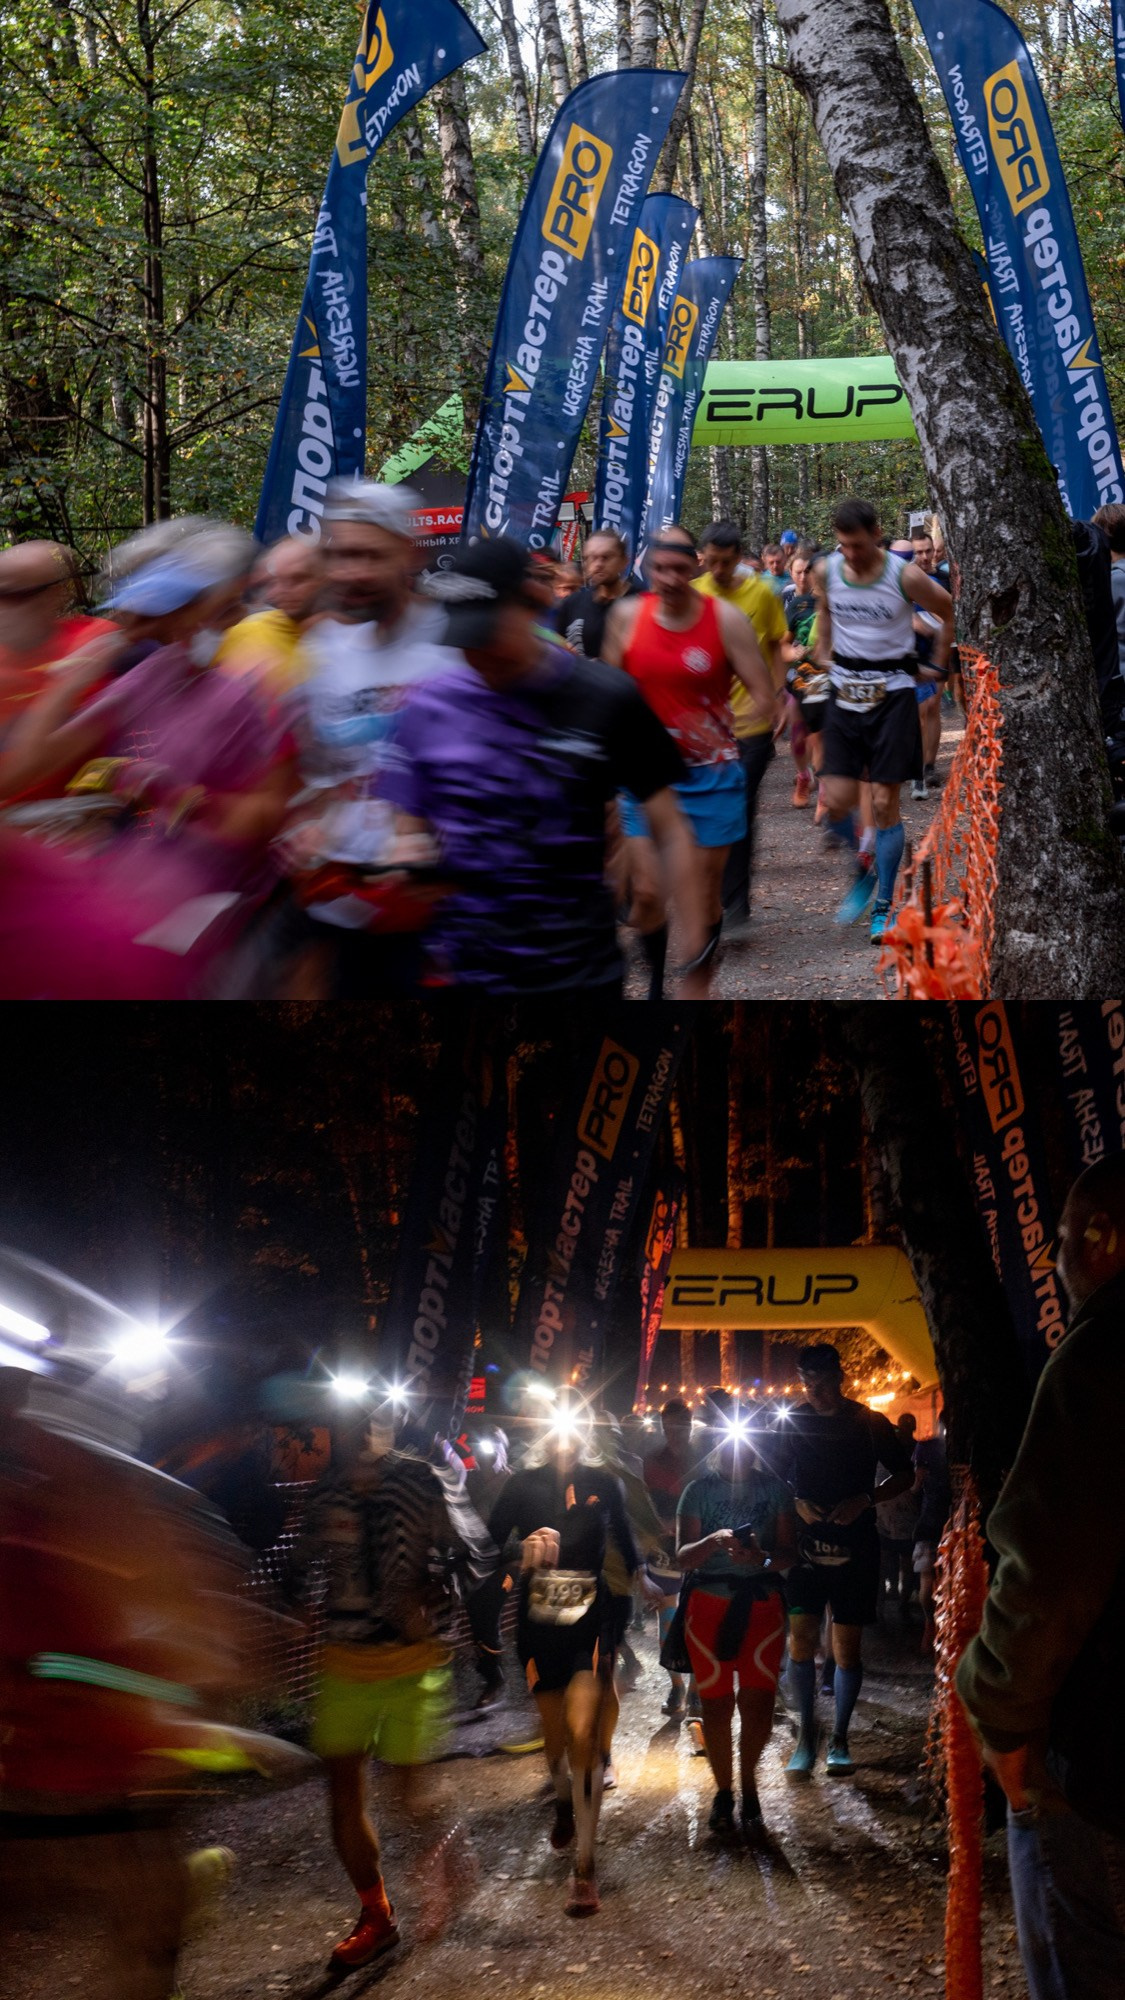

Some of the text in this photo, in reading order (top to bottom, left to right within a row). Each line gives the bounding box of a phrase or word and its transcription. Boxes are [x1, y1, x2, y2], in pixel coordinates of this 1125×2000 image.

[550, 140, 601, 248] PRO
[610, 133, 652, 226] TETRAGON
[628, 242, 655, 318] PRO
[658, 241, 682, 310] TETRAGON
[562, 276, 608, 416] UGRESHA TRAIL
[696, 297, 720, 357] TETRAGON
[674, 388, 696, 479] UGRESHA TRAIL
[701, 384, 903, 422] ERUP
[532, 469, 560, 527] TRAIL
[849, 685, 876, 700] 167
[635, 1048, 673, 1133] TETRAGON
[530, 1053, 629, 1372] портМастер PRO
[609, 1175, 634, 1221] TRAIL
[665, 1274, 859, 1306] ERUP
